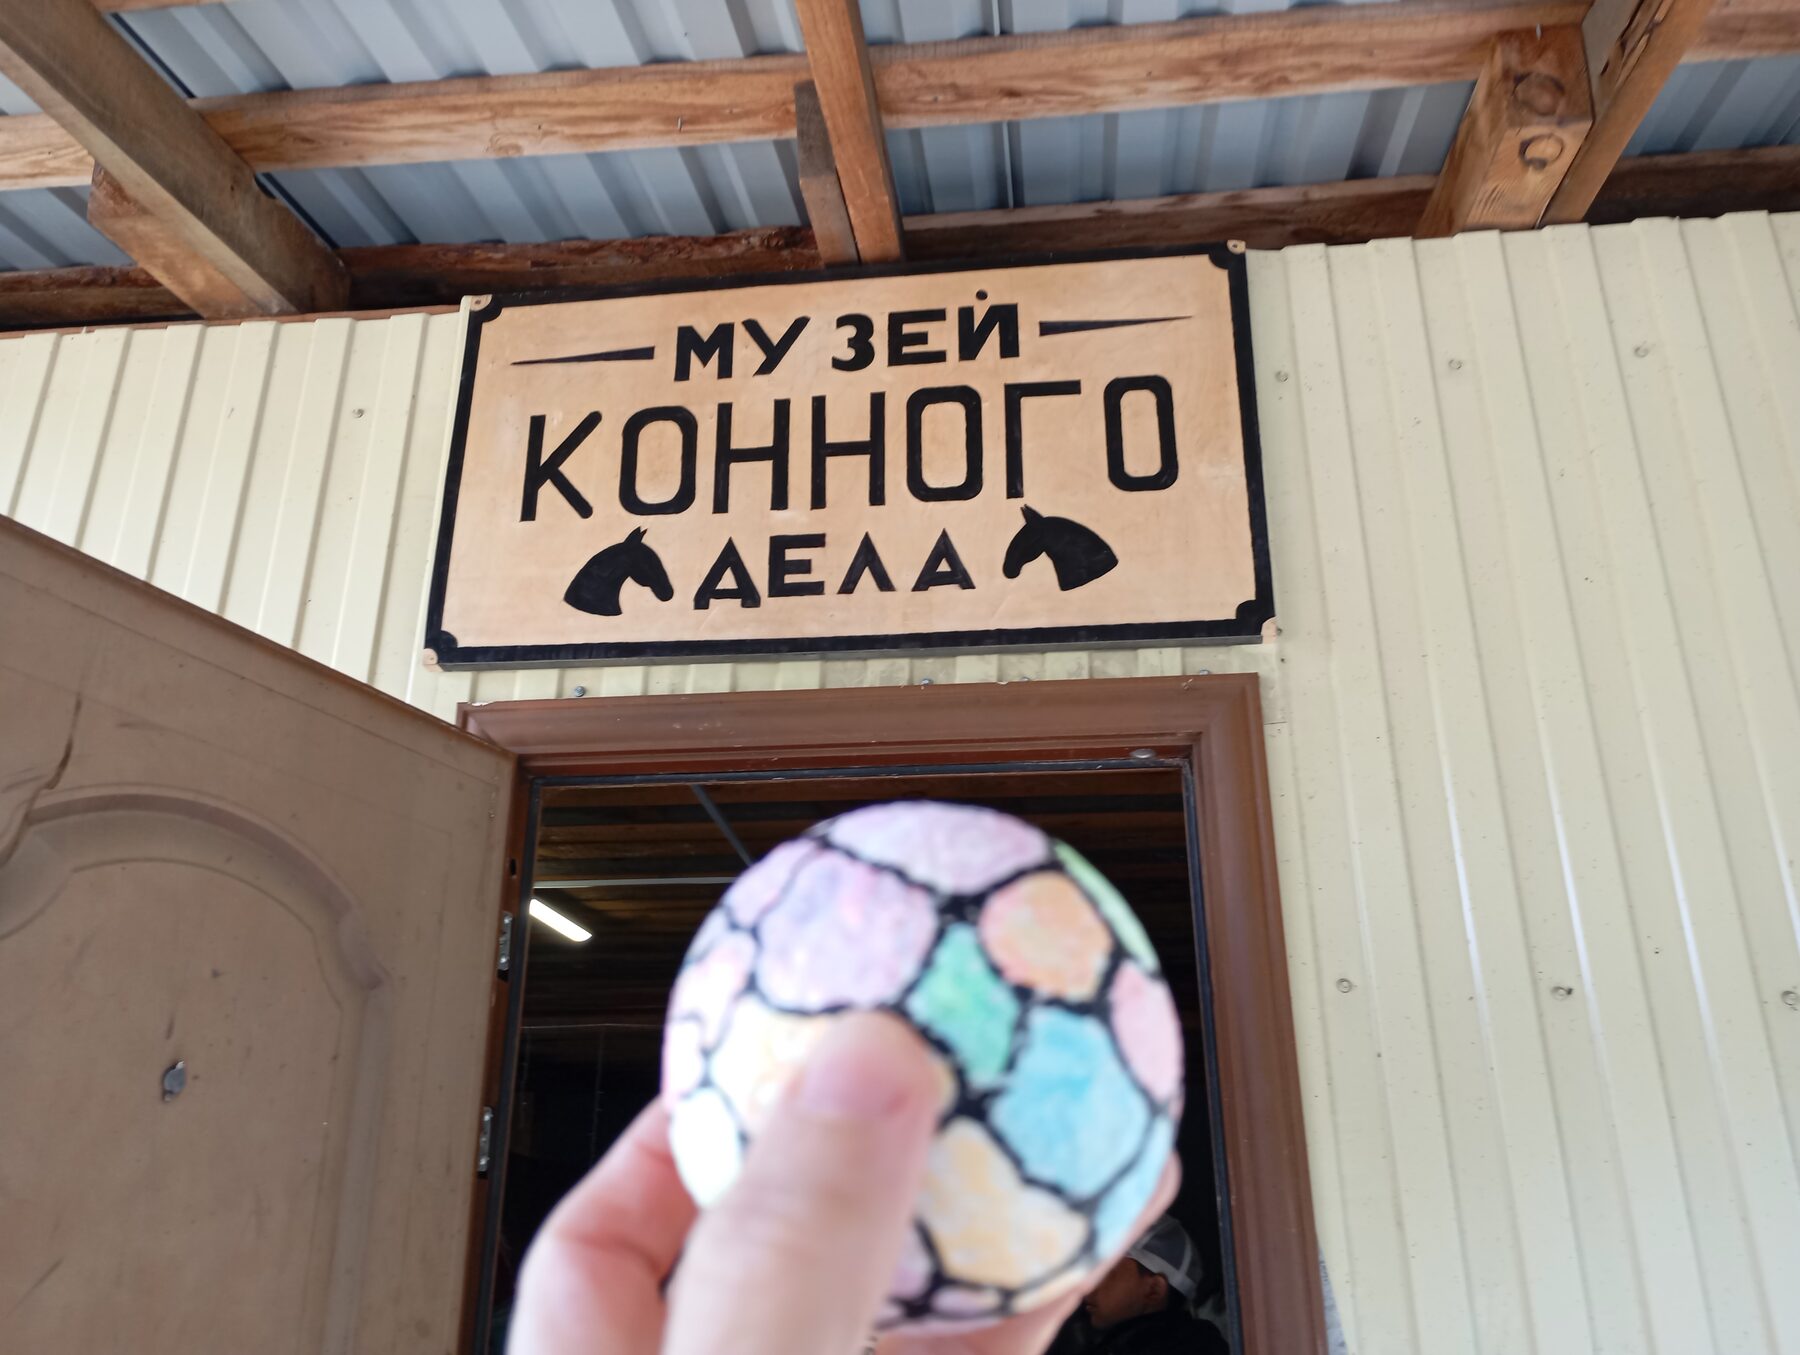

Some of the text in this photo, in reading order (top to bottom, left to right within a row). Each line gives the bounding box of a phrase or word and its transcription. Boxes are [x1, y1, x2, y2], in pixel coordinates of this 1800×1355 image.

[673, 289, 1020, 382] МУЗЕЙ
[520, 374, 1179, 522] КОННОГО
[693, 528, 976, 610] ДЕЛА
